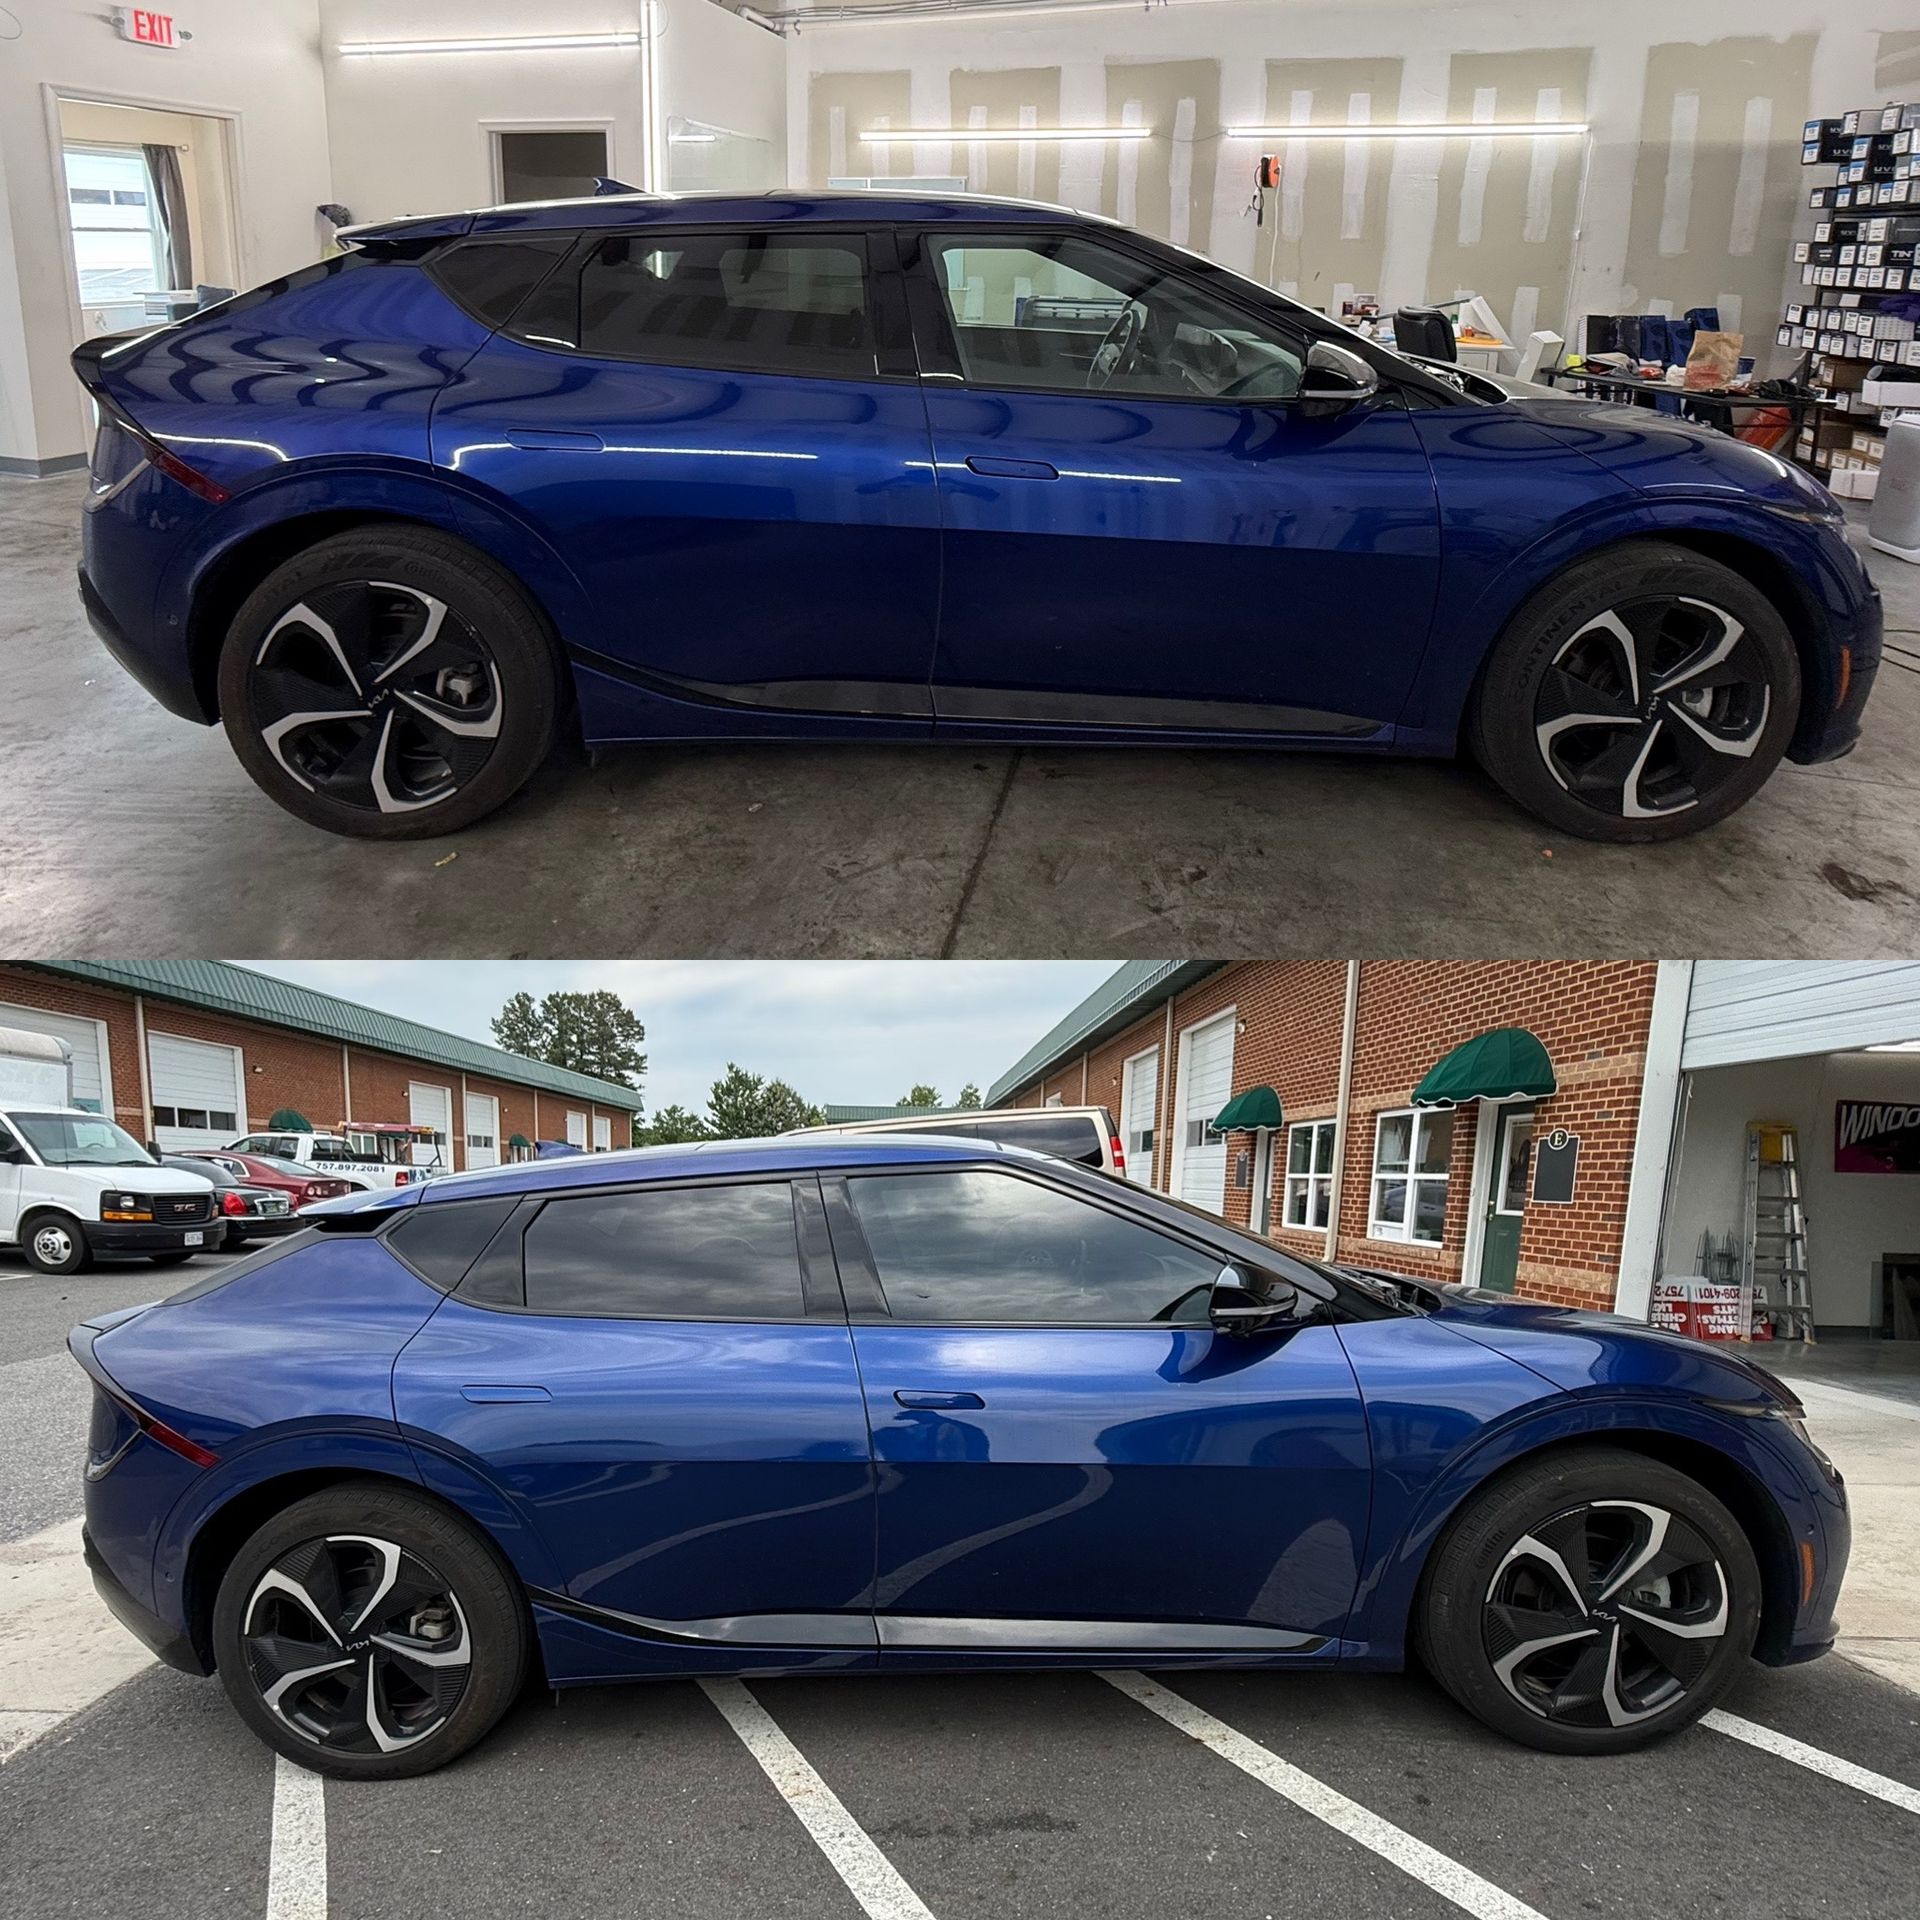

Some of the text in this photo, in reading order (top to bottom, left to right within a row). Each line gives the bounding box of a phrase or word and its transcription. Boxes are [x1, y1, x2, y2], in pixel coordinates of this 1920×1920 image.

[133, 10, 172, 45] EXIT
[1553, 1131, 1564, 1146] E
[316, 1161, 386, 1173] 757.897.2081
[174, 1203, 196, 1212] GMC
